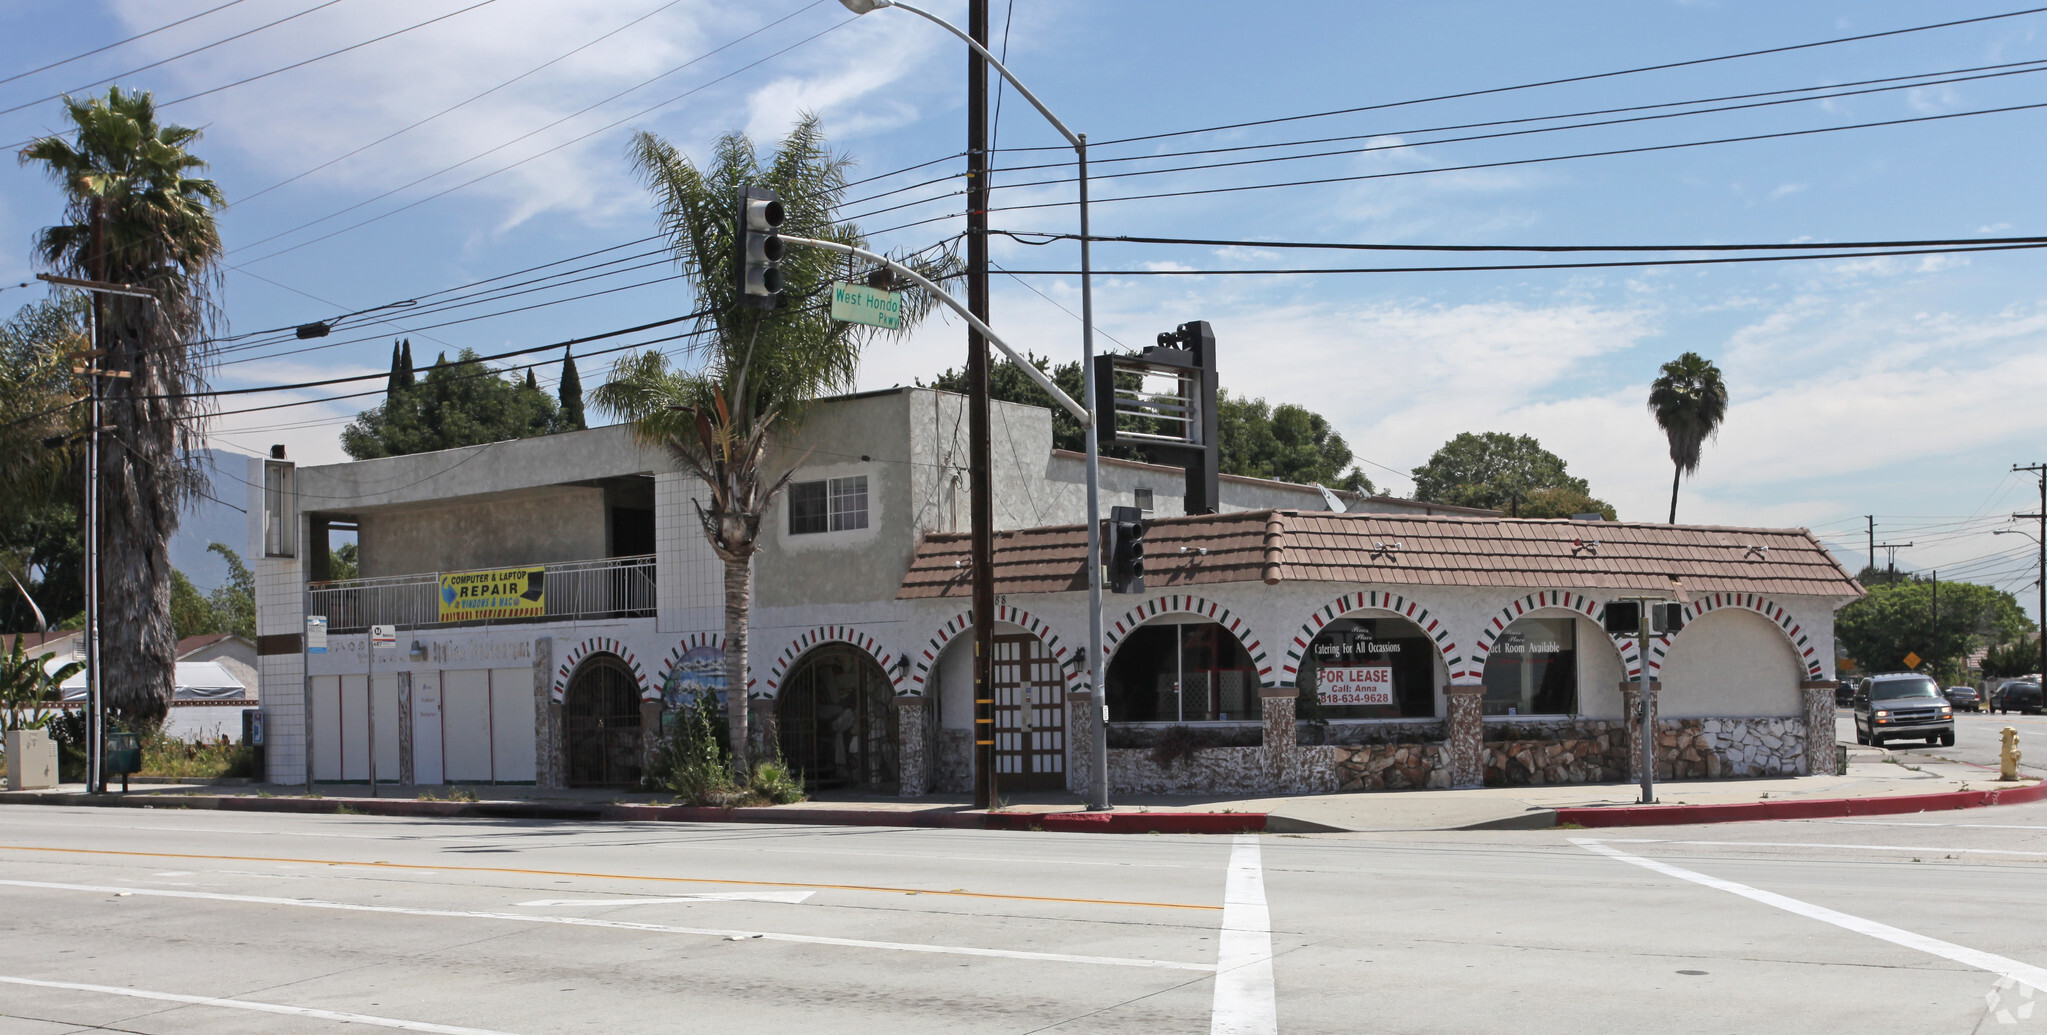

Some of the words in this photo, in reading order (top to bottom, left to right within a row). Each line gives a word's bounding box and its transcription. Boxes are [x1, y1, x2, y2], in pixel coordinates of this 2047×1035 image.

[836, 288, 862, 306] West
[866, 294, 898, 313] Hondo
[878, 312, 899, 328] Pkwy
[451, 572, 489, 585] COMPUTER
[491, 573, 496, 582] &
[499, 570, 527, 581] LAPTOP
[460, 582, 518, 598] REPAIR
[461, 597, 489, 609] WINDOWS
[499, 596, 513, 607] MAC
[1314, 643, 1340, 658] Catering
[1343, 643, 1352, 654] For
[1356, 642, 1365, 653] All
[1368, 642, 1400, 653] Occassions
[1505, 643, 1525, 653] Room
[1529, 642, 1560, 653] Available
[1320, 670, 1344, 683] FOR
[1349, 670, 1388, 682] LEASE
[1331, 684, 1352, 693] Call:
[1354, 684, 1377, 693] Anna
[1320, 693, 1389, 704] 818-634-9628
